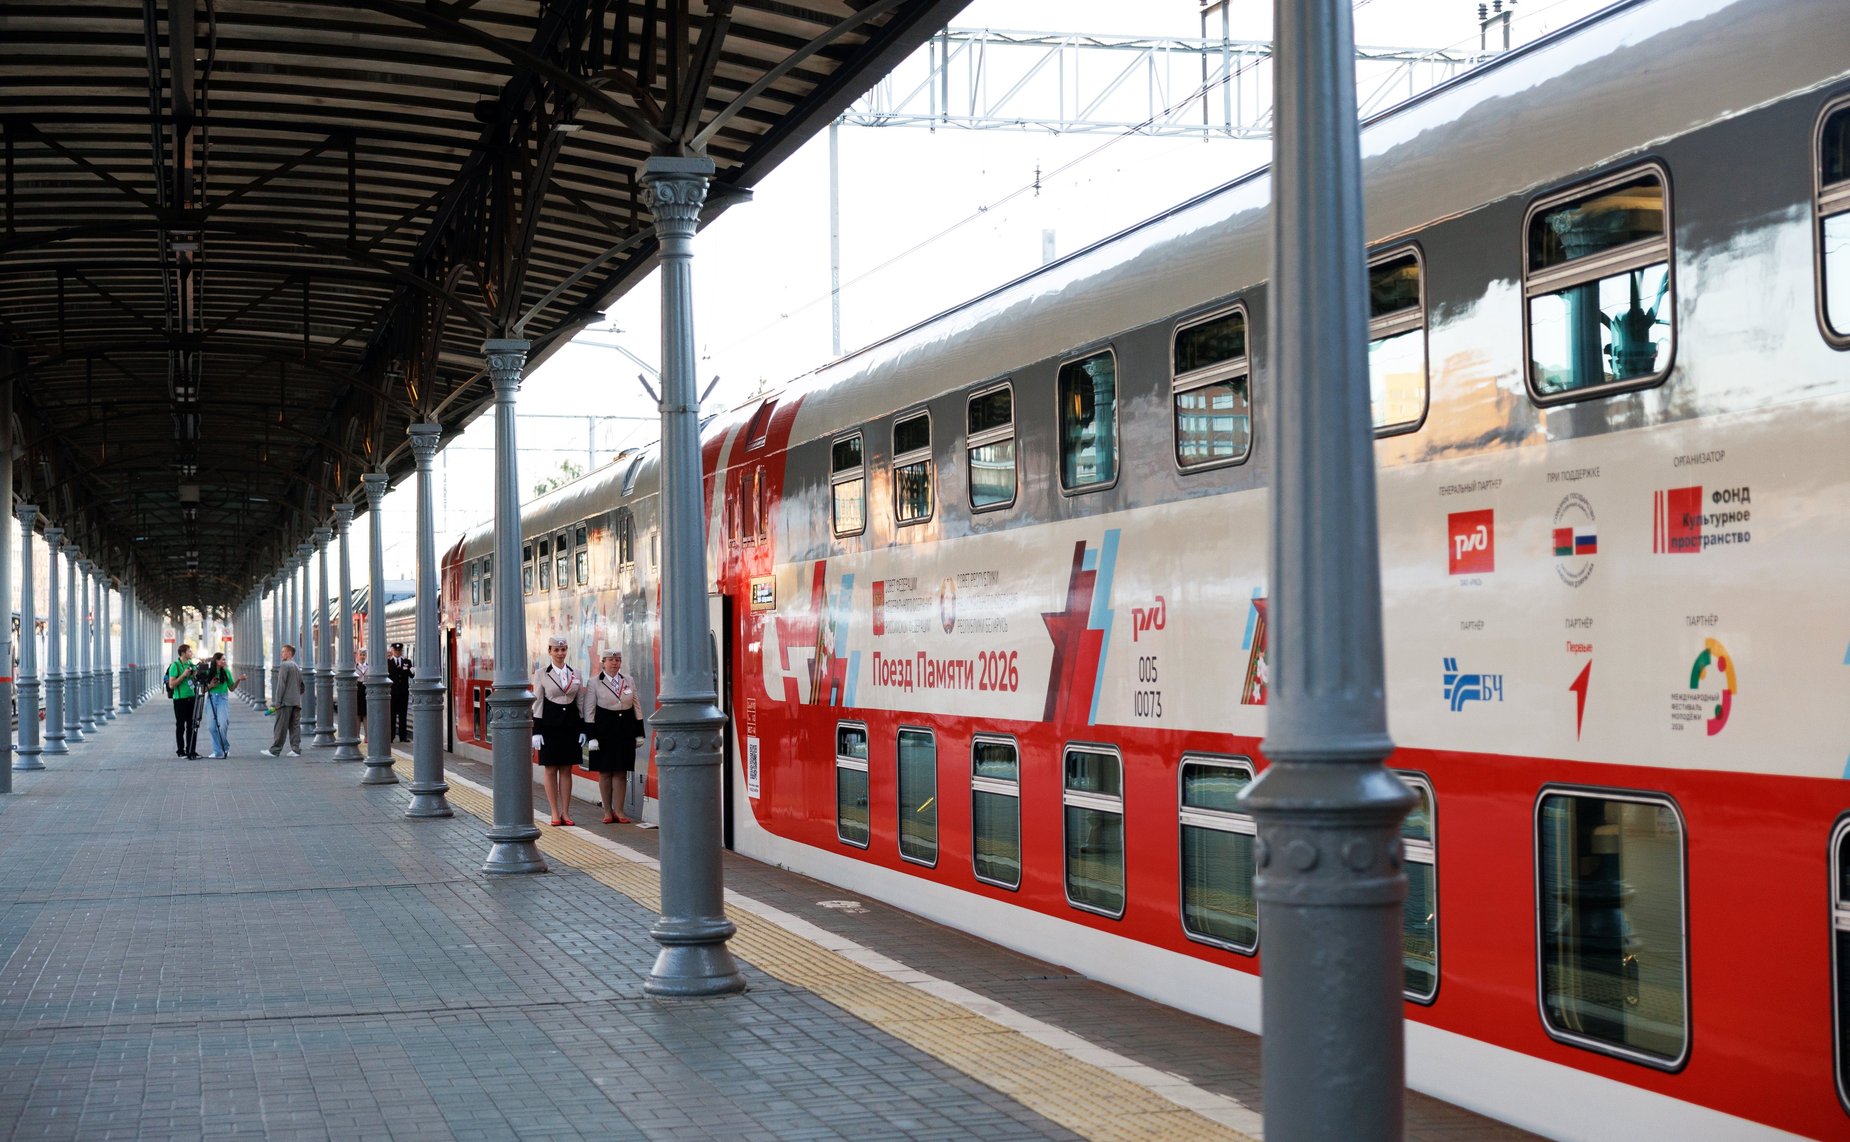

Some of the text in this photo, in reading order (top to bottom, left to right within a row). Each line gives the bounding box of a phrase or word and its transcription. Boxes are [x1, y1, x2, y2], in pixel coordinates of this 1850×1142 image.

[1673, 450, 1726, 467] ОРГАНИЗАТОР
[1561, 467, 1600, 482] ПОДДЕРЖКЕ
[1712, 487, 1751, 504] ФОНД
[1683, 510, 1750, 530] Культурное
[1671, 531, 1751, 549] пространство
[1565, 616, 1593, 629] ПАРТНЁР
[1686, 614, 1719, 626] ПАРТНЁР
[873, 650, 1019, 693] Поезд Памяти 2026
[1139, 656, 1158, 682] 005
[1481, 674, 1504, 702] БЧ
[1134, 691, 1162, 718] 10073
